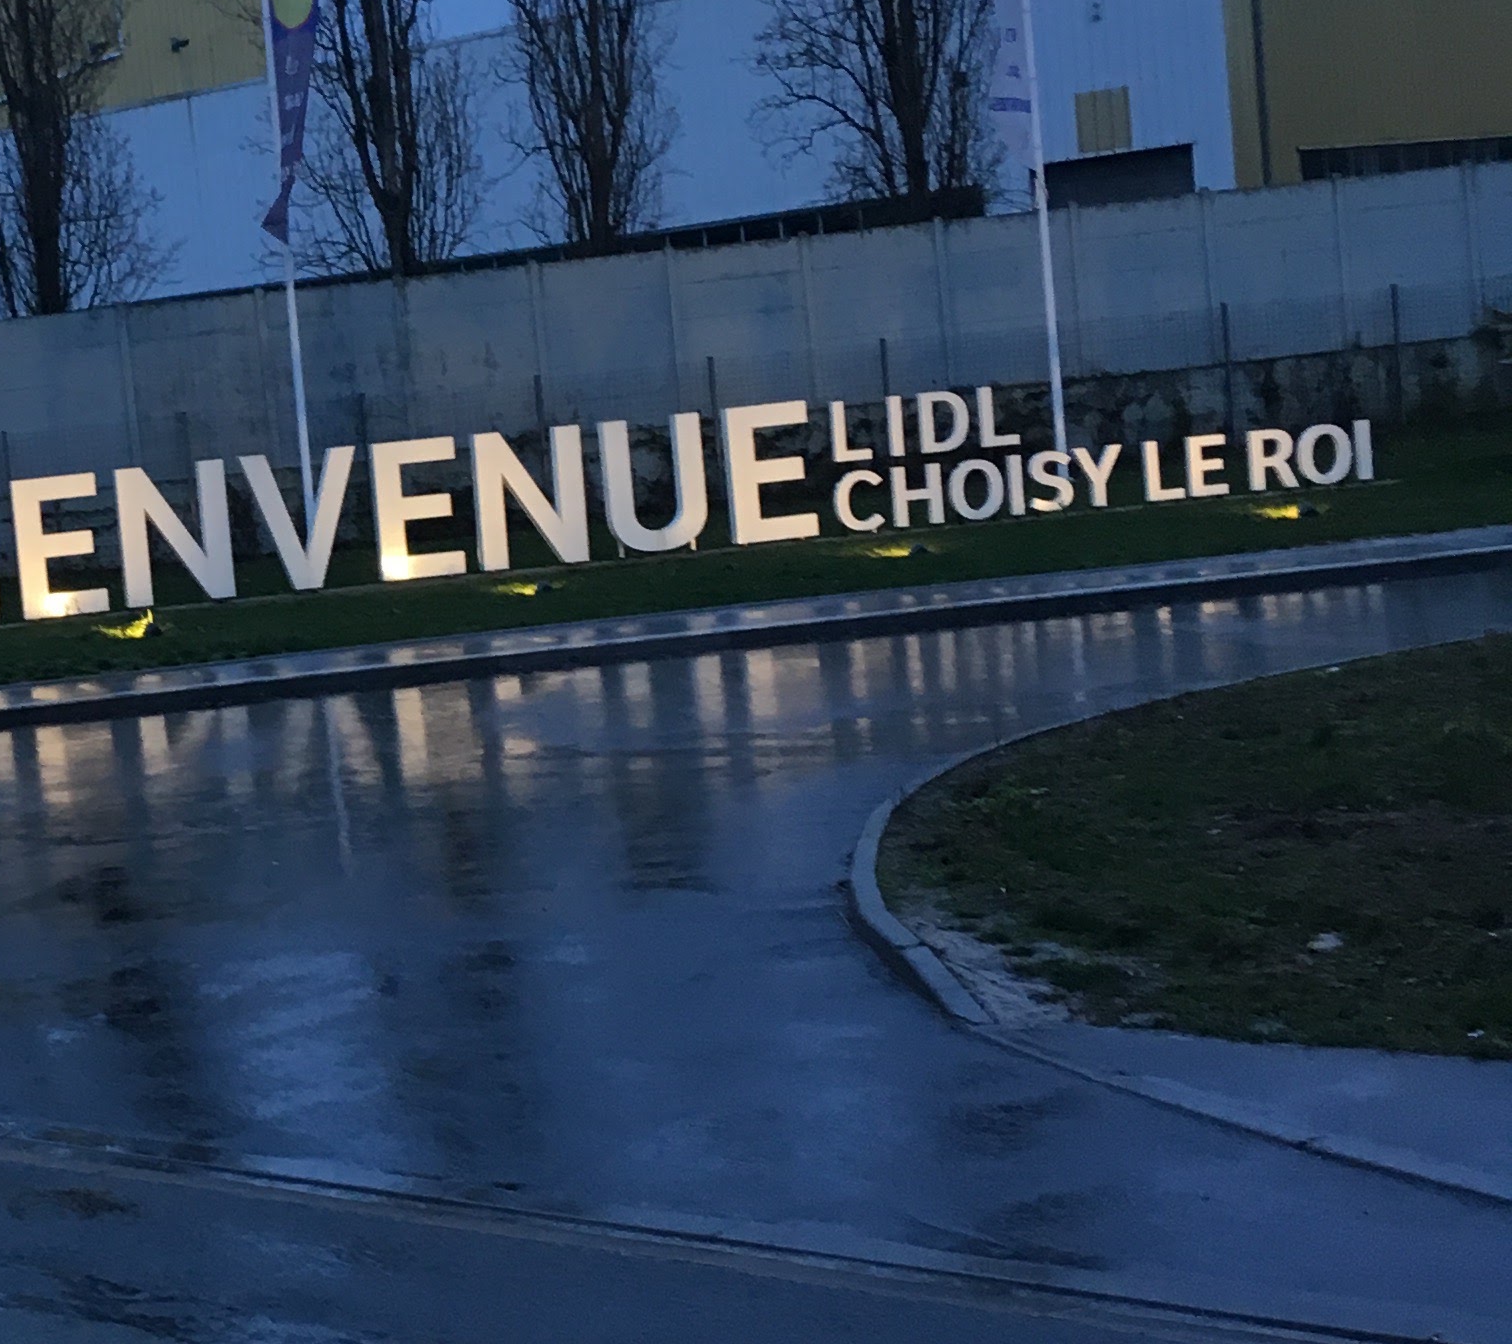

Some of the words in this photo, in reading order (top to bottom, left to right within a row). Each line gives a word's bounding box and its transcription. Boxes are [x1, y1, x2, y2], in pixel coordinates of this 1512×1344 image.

[828, 386, 1021, 463] LIDL
[832, 442, 1123, 533] CHOISY
[1140, 433, 1231, 503] LE
[1245, 418, 1375, 492] ROI
